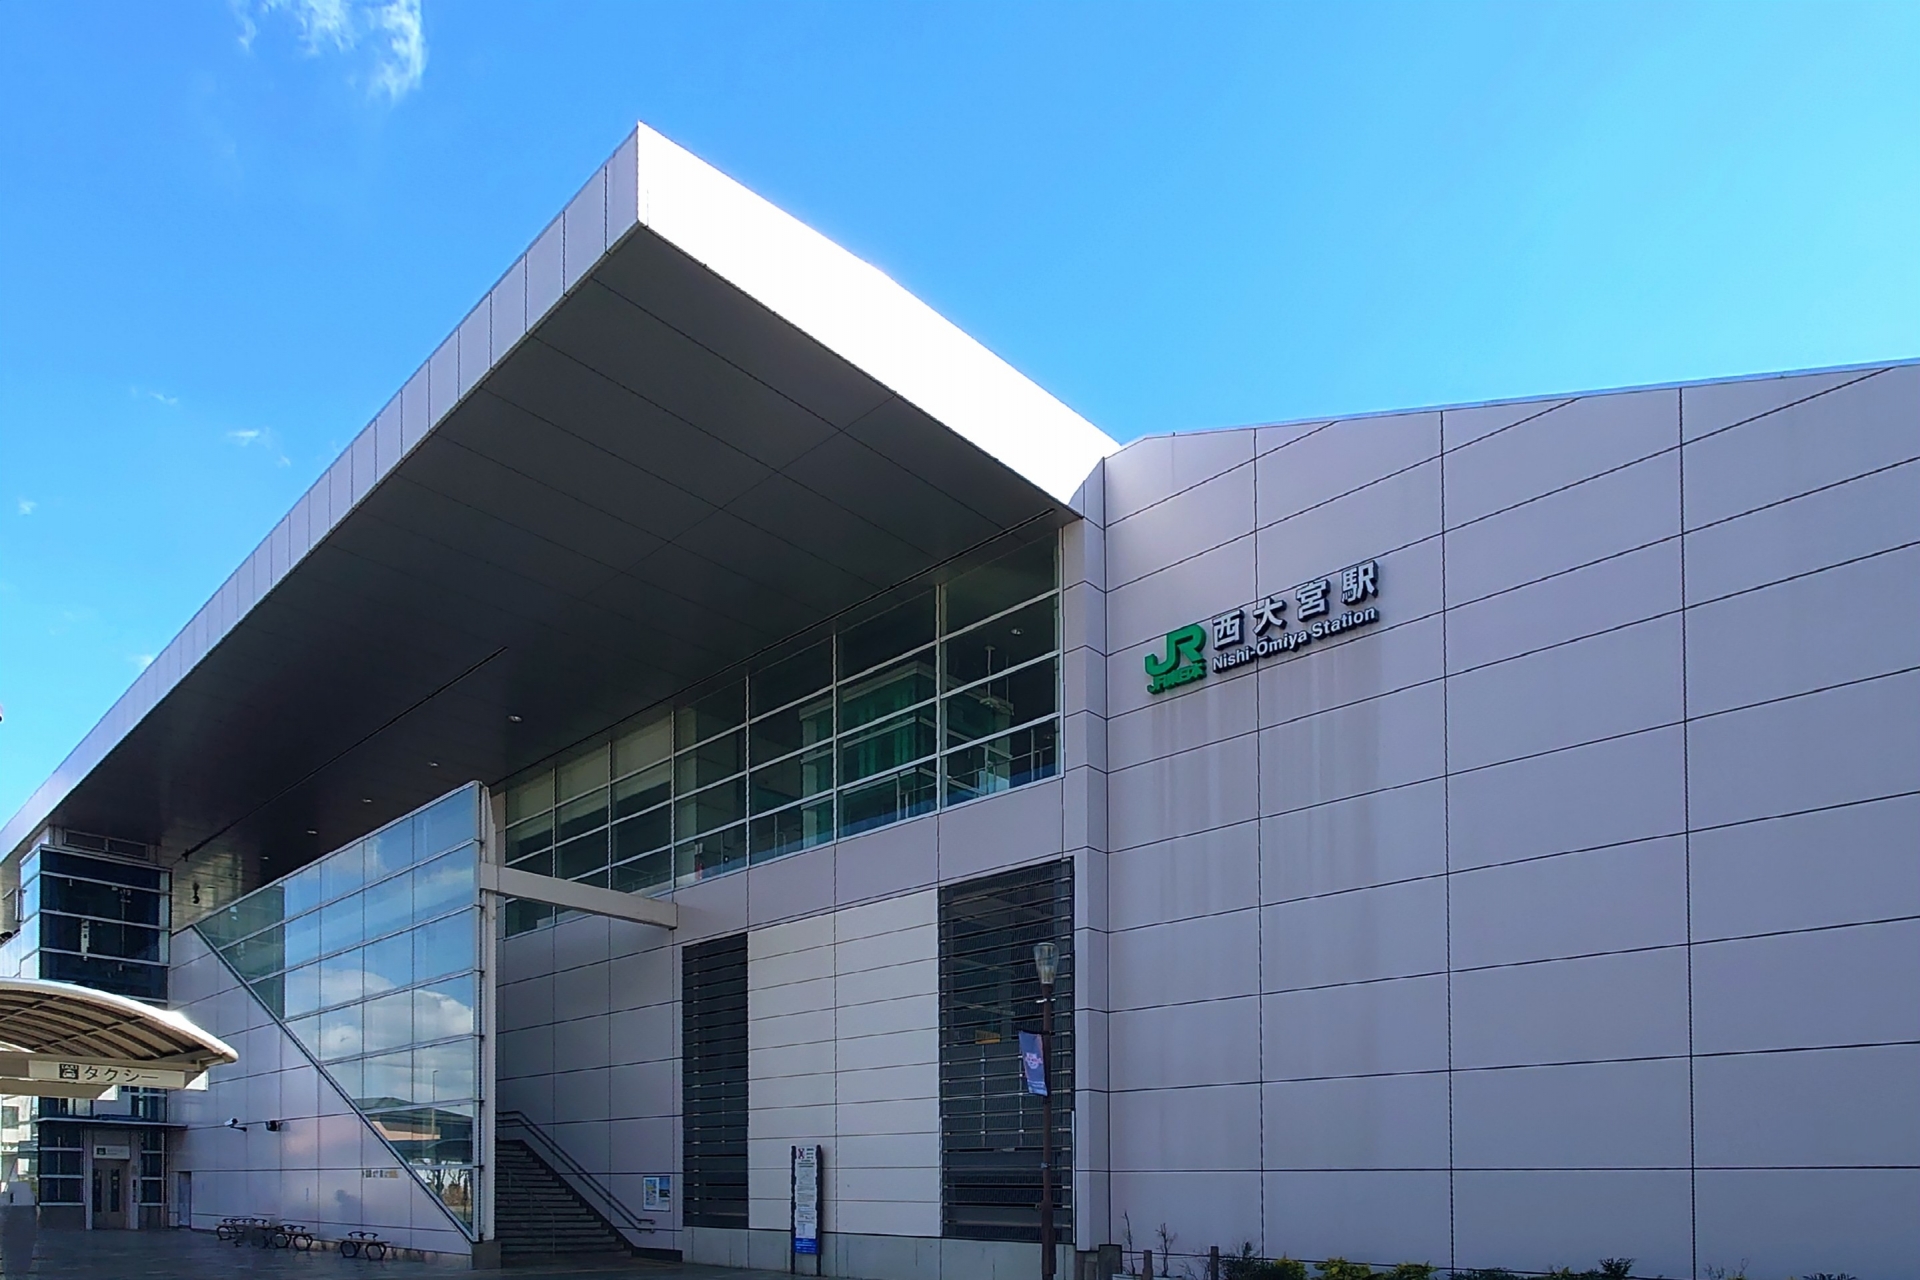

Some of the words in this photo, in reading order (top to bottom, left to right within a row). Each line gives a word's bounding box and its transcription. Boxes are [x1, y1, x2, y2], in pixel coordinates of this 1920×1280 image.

[1212, 560, 1378, 649] 西大宮駅
[1311, 607, 1377, 639] Station
[1145, 625, 1206, 677] JR
[84, 1066, 159, 1082] タクシー
